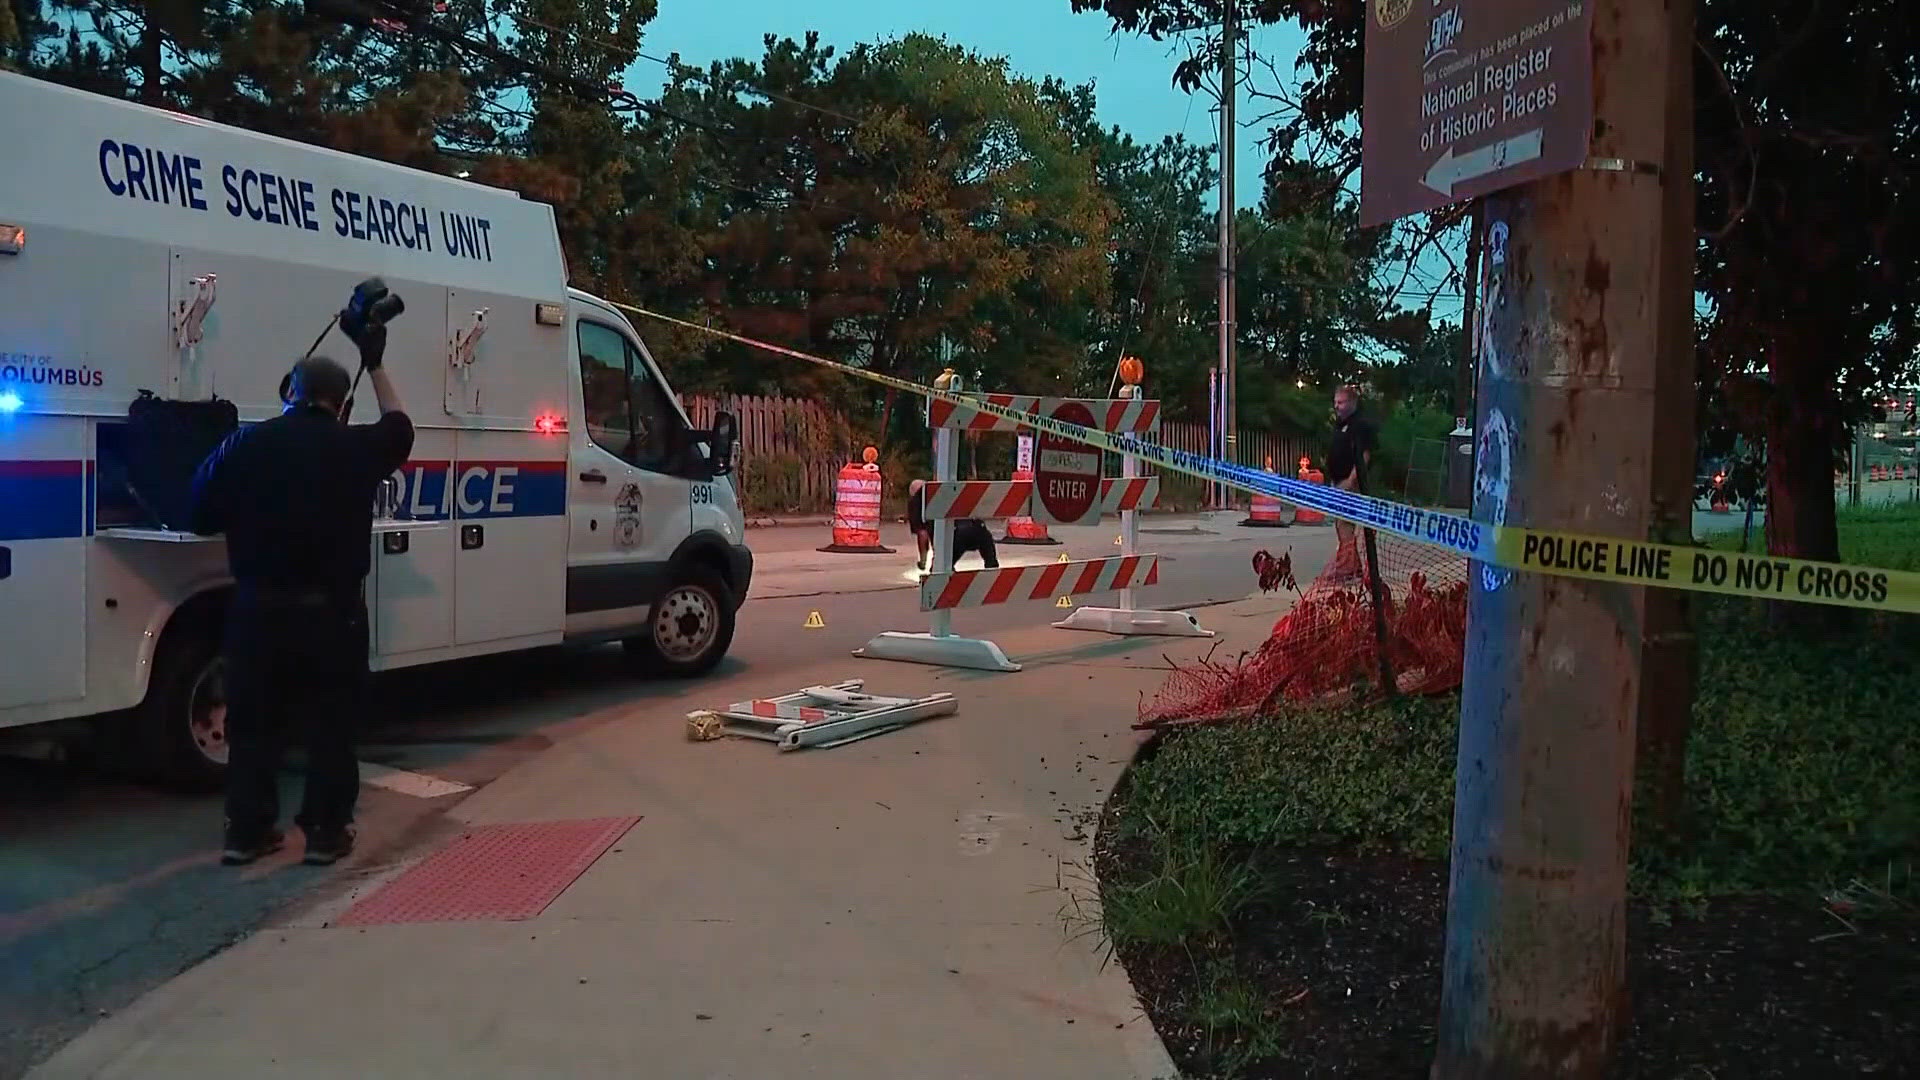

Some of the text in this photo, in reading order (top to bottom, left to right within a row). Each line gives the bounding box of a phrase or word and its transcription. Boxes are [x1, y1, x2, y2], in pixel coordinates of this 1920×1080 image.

[1480, 46, 1494, 60] has
[1497, 34, 1518, 52] been
[1520, 16, 1549, 45] placed
[1552, 12, 1564, 28] on
[1567, 3, 1582, 20] the
[1421, 46, 1552, 120] National Register
[1420, 82, 1557, 152] of Historic Places
[100, 139, 492, 262] CRIME SCENE SEARCH UNIT
[692, 485, 712, 504] 991
[1049, 480, 1087, 499] ENTER
[1391, 504, 1425, 535] NOT
[1427, 514, 1480, 551] CROSS
[1523, 535, 1888, 603] POLICE LINE DO NOT CROSS
